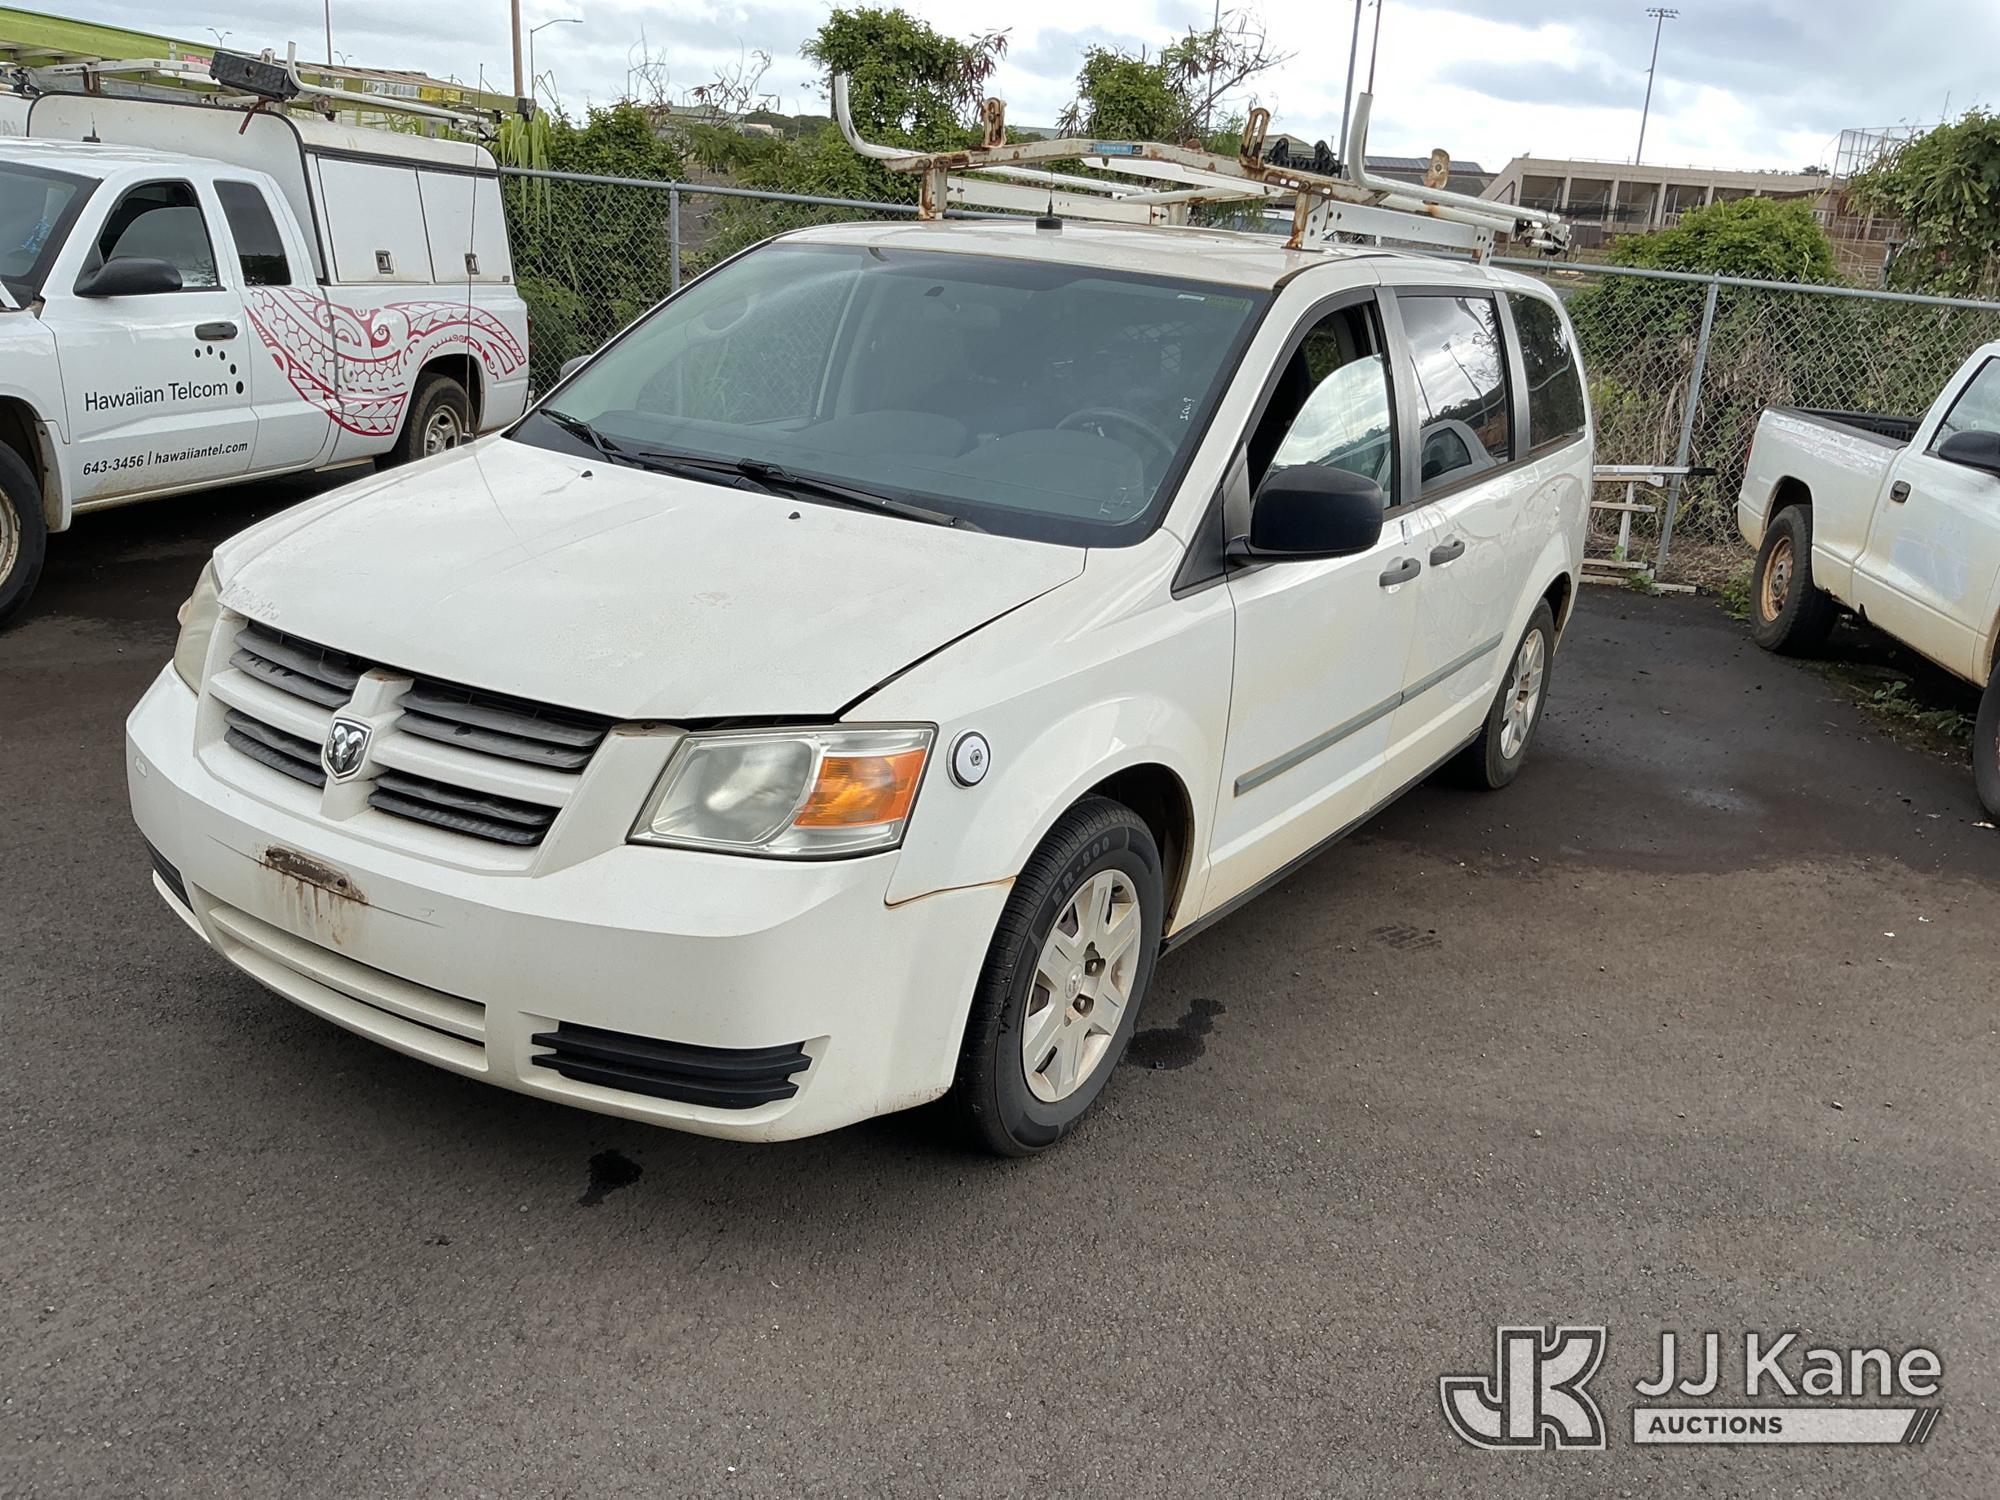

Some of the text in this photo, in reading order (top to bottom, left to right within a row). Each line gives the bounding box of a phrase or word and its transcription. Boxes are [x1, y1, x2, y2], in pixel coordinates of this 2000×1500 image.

[85, 381, 228, 412] Hawaiian Telcom
[83, 454, 144, 476] 643-3456
[154, 441, 248, 465] hawaiiantel.com
